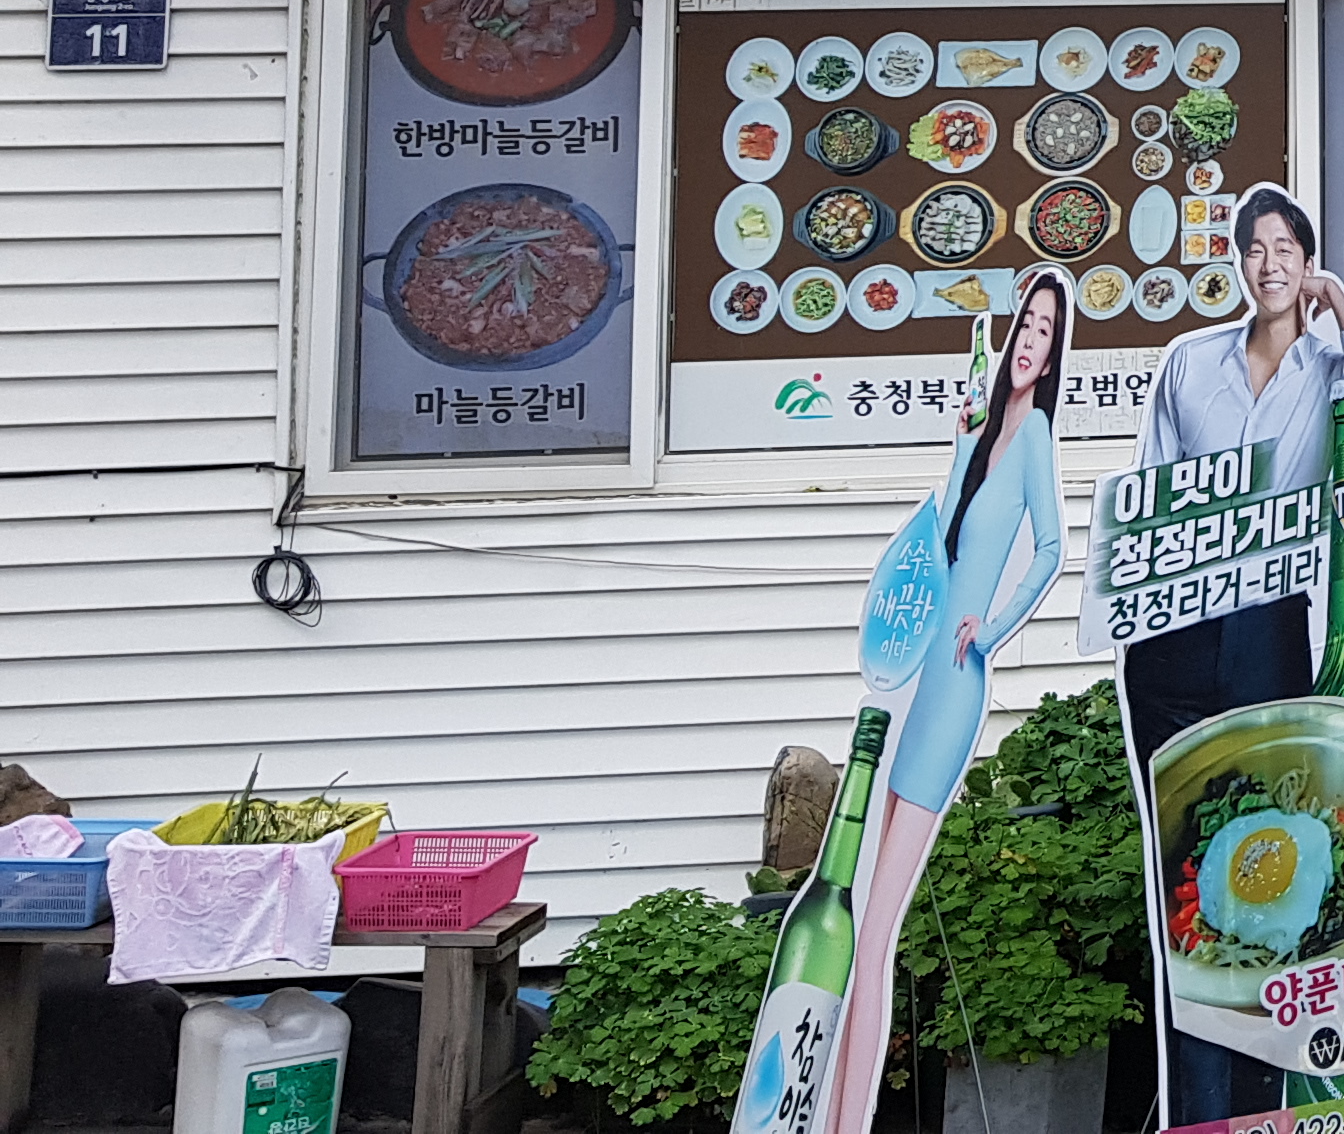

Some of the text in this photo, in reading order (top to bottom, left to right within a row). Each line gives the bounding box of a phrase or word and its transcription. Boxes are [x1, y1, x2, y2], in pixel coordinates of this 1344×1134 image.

[85, 23, 128, 57] 11
[392, 116, 621, 159] 한방마늘등갈비
[414, 382, 588, 427] 마늘등갈비
[1115, 444, 1254, 524] 이 맛이
[896, 539, 934, 578] 소주는
[1109, 485, 1323, 588] 청정라거다!
[872, 583, 935, 637] 깨끗함
[1107, 544, 1323, 641] 청정라거-테라
